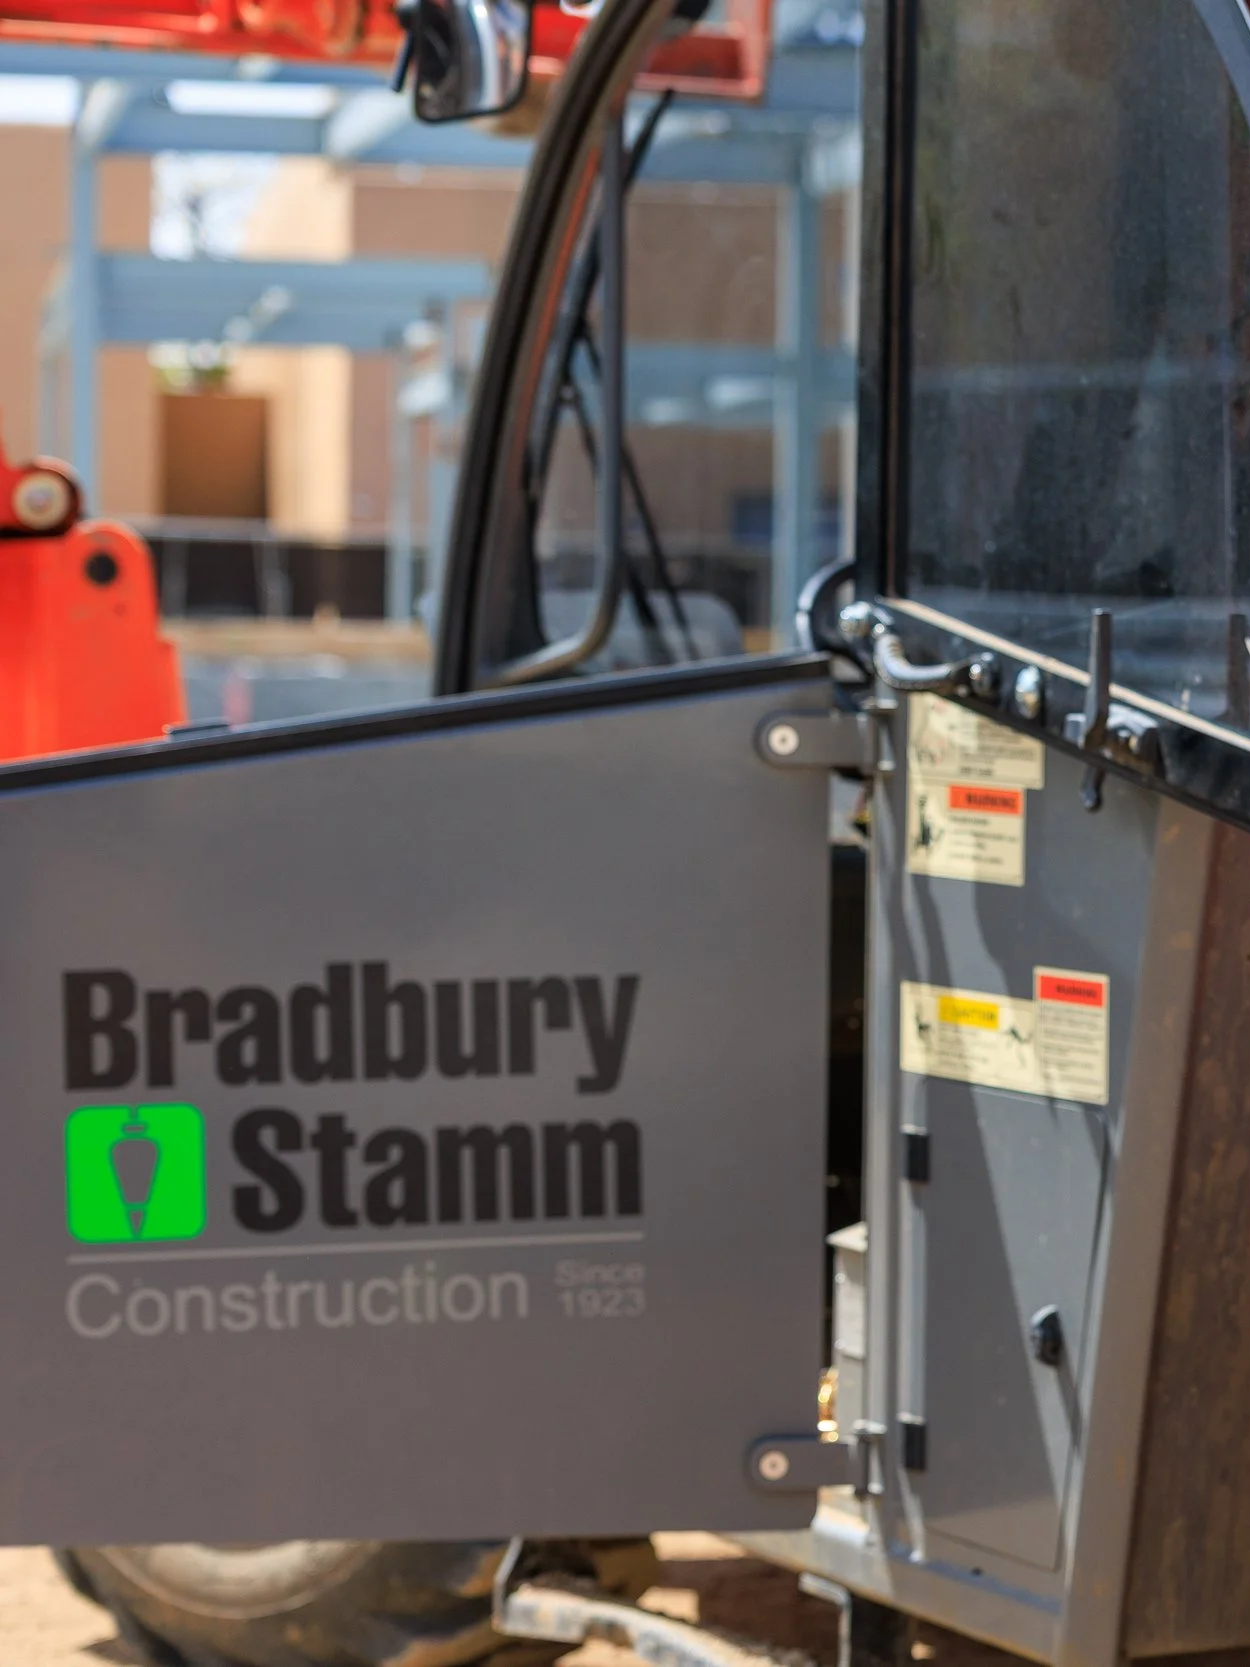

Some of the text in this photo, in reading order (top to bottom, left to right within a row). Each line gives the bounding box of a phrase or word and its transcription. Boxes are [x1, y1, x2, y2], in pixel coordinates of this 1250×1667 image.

[62, 961, 640, 1094] Bradbury
[231, 1108, 643, 1233] Stamm
[65, 1262, 529, 1338] Construction
[555, 1260, 645, 1288] Since
[561, 1288, 645, 1318] 1923
